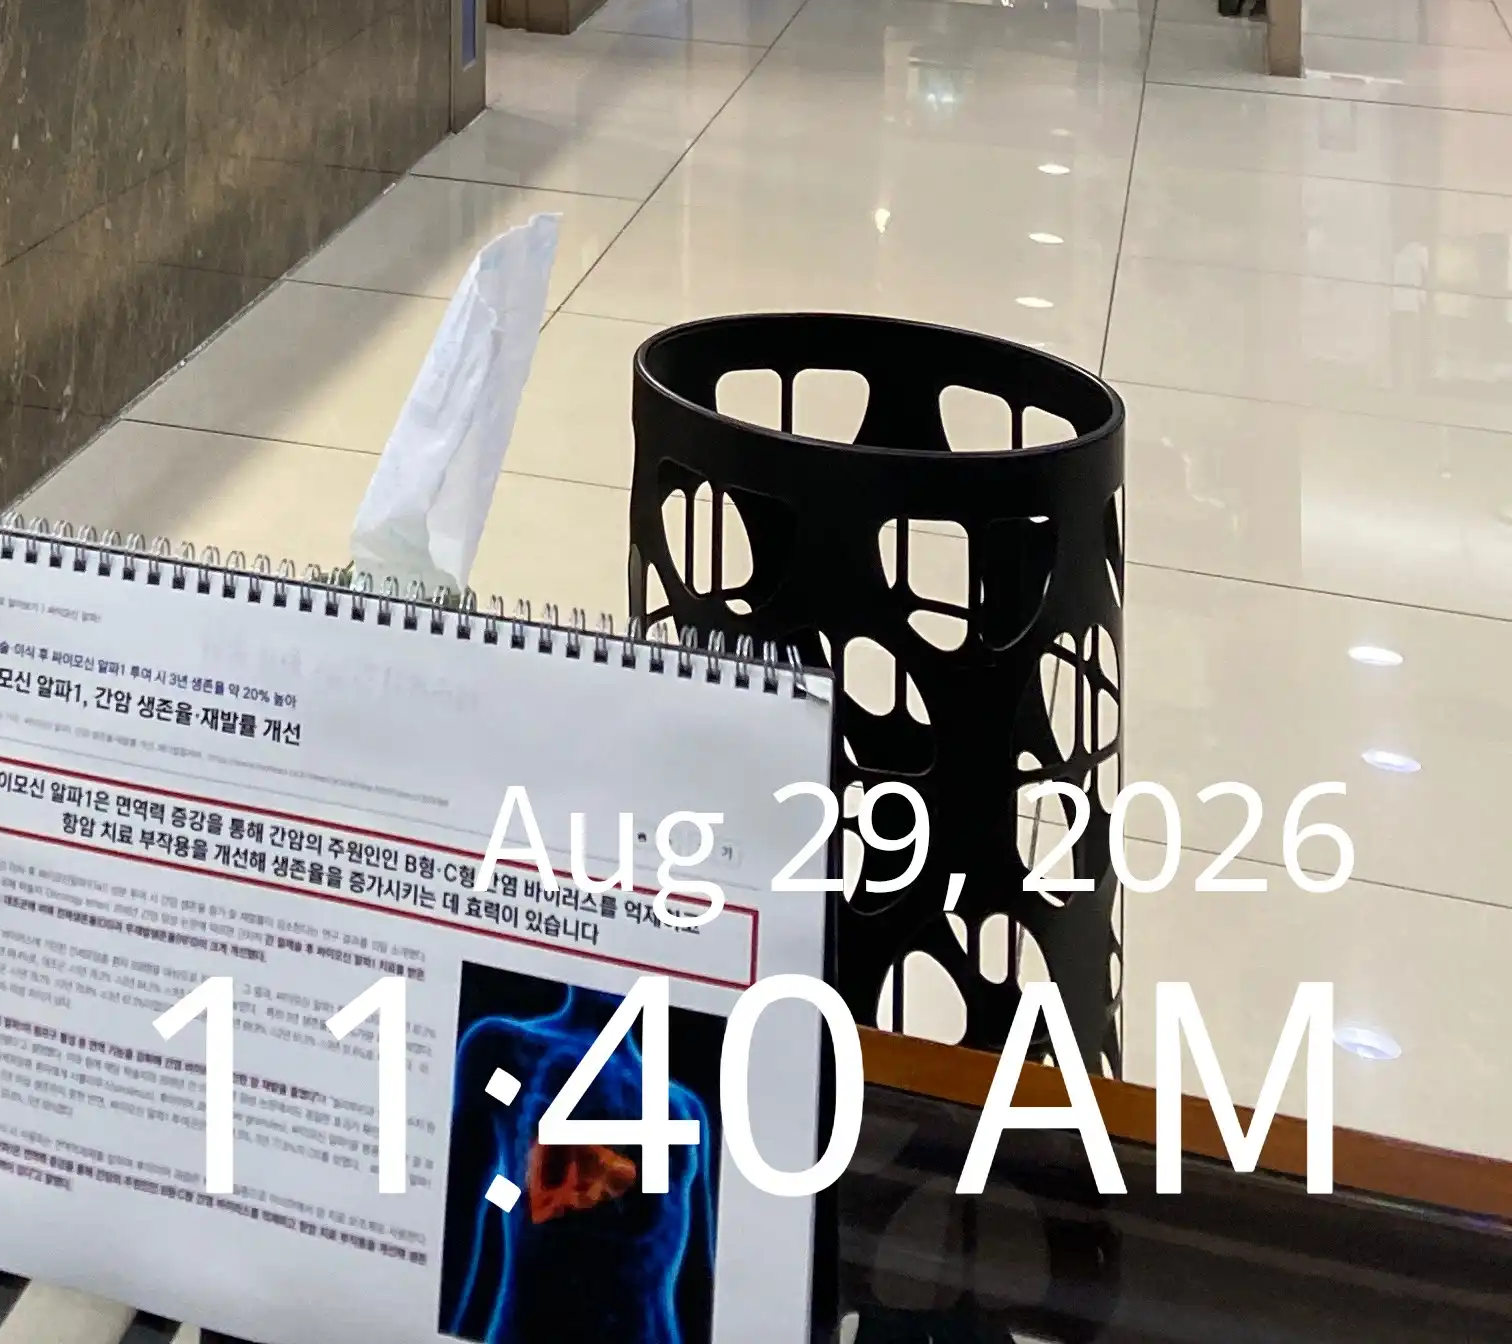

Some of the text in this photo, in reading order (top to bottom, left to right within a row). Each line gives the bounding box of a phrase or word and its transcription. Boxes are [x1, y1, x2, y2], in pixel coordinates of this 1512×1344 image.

[37, 674, 88, 708] 알파1,
[93, 685, 133, 714] 간암
[137, 694, 258, 739] 생존율·재발률
[262, 717, 303, 748] 개선
[38, 647, 49, 662] 후
[51, 648, 95, 672] 싸이모신
[98, 659, 126, 678] 알파1
[130, 664, 153, 684] 투여
[155, 670, 167, 687] 시
[169, 672, 189, 690] 3년
[191, 675, 225, 696] 생존율
[228, 682, 241, 699] 약
[242, 686, 271, 704] 20%
[273, 691, 298, 709] 높아
[50, 781, 111, 814] 알파1은
[115, 793, 166, 826] 면역력
[171, 805, 225, 836] 증강을
[229, 816, 266, 845] 통해
[269, 824, 324, 857] 간암의
[327, 837, 399, 873] 주원인인
[404, 853, 477, 889] B형·C형
[523, 878, 618, 920] 바이러스를
[62, 811, 600, 947] 항암 치료 부작용을 개선해 생존율을 증가시키는 데 효력이 있습니다
